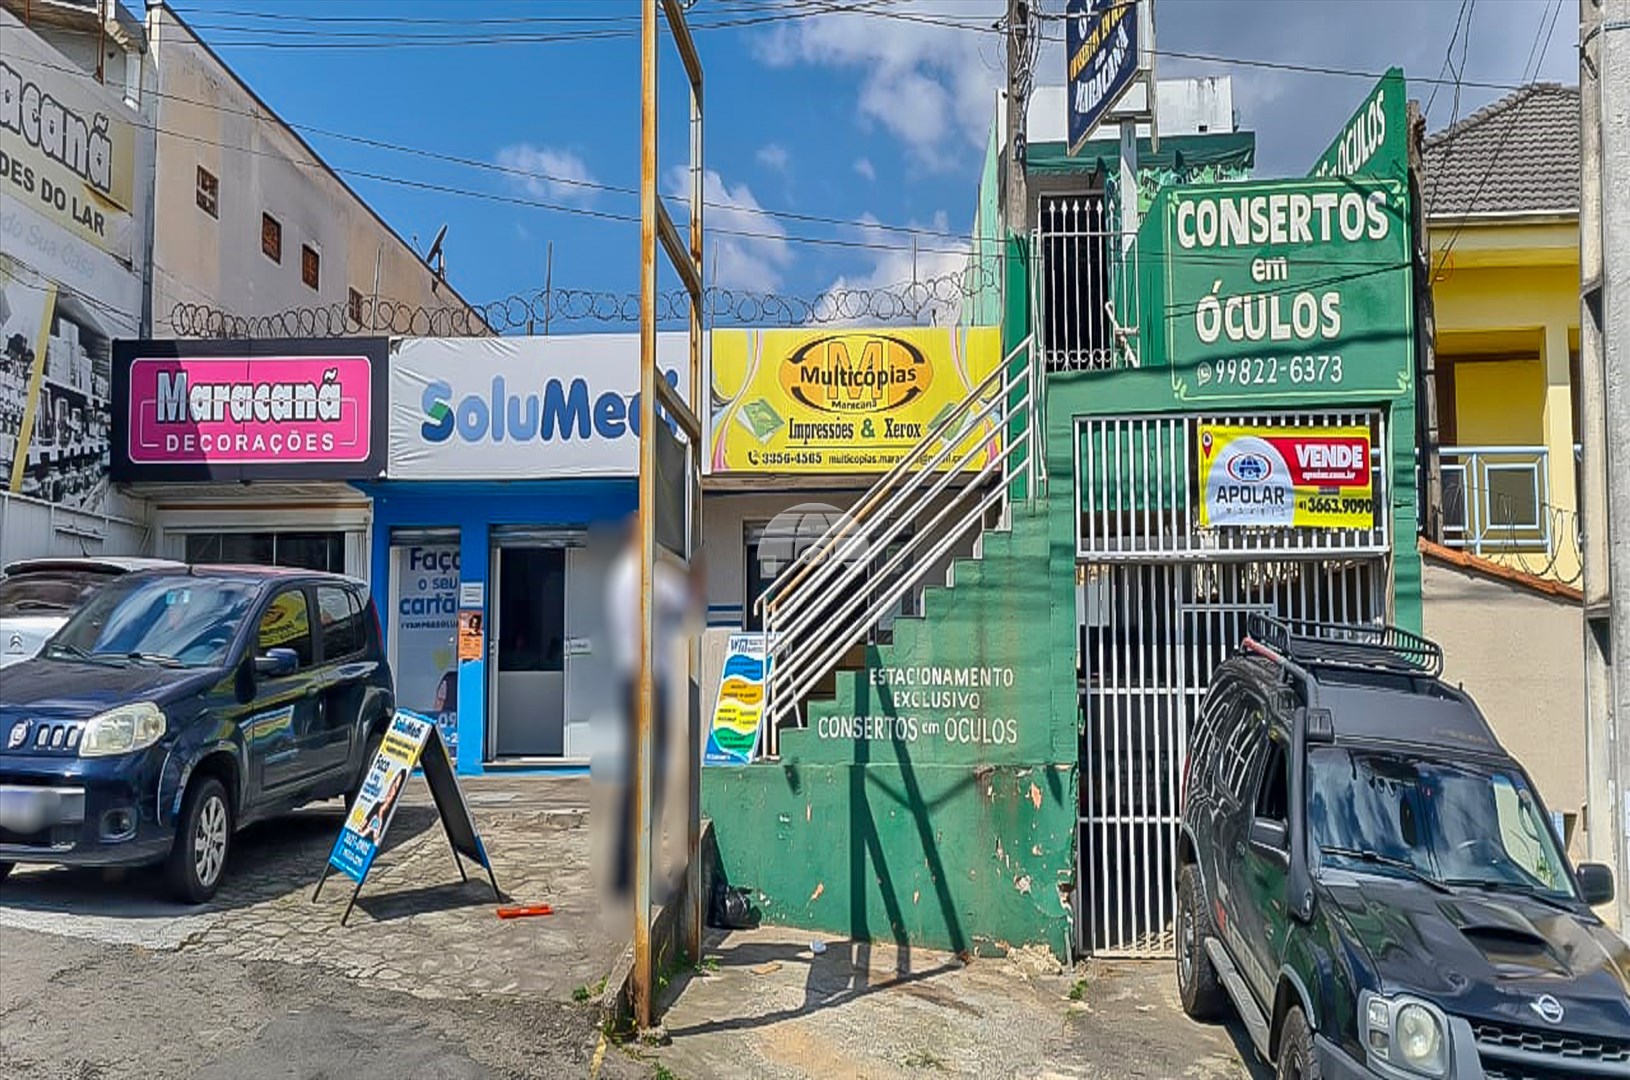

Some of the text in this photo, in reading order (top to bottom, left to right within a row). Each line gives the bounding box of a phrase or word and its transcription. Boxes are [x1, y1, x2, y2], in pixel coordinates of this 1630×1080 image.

[41, 178, 66, 211] DO
[72, 196, 105, 238] LAR
[1177, 191, 1390, 249] CONSERTOS
[1251, 256, 1288, 281] em
[1195, 280, 1341, 342] ÓCULOS
[800, 363, 917, 391] Multicópias
[1215, 355, 1343, 385] 99822-6373
[156, 368, 342, 423] Maracanã
[861, 418, 875, 438] &
[884, 417, 921, 438] Xerox
[167, 430, 335, 456] DECORAÇÕES
[762, 451, 822, 464] 3356-4565
[1295, 444, 1364, 469] VENDE
[1216, 485, 1285, 505] APOLAR
[1308, 497, 1373, 514] 3663.9090
[418, 577, 458, 590] o seu
[400, 592, 458, 615] cartã
[869, 667, 1014, 687] ESTACIONAMENTO
[893, 691, 981, 710] EXCLUSIVO
[818, 711, 1017, 744] CONSERTOS em ÓCULOS
